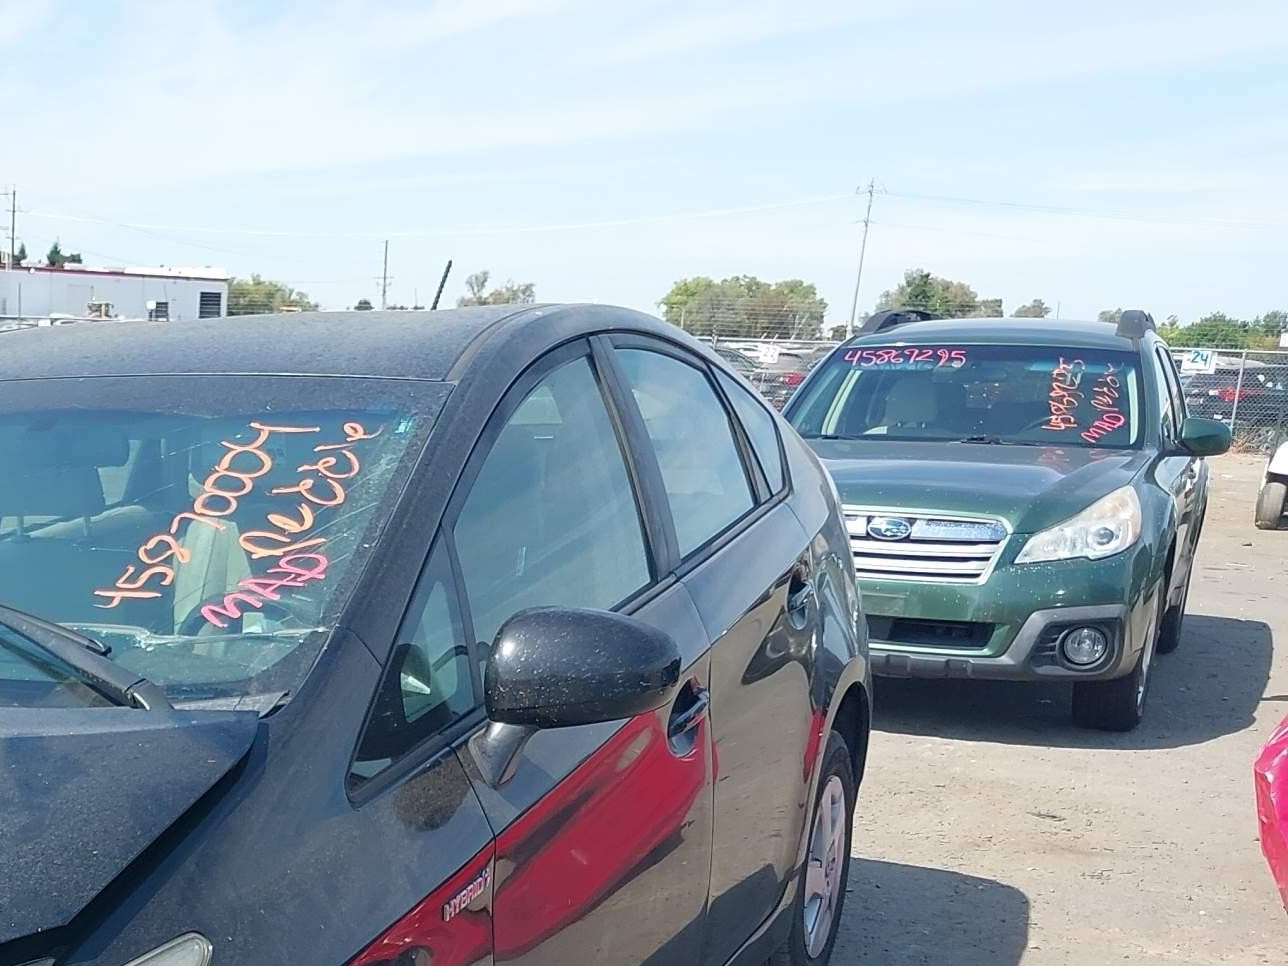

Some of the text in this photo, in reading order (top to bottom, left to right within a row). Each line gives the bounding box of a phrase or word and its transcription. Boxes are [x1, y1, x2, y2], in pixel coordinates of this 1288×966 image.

[1191, 350, 1209, 367] 24
[93, 421, 320, 609] 45870004
[442, 876, 485, 922] HYBRID
